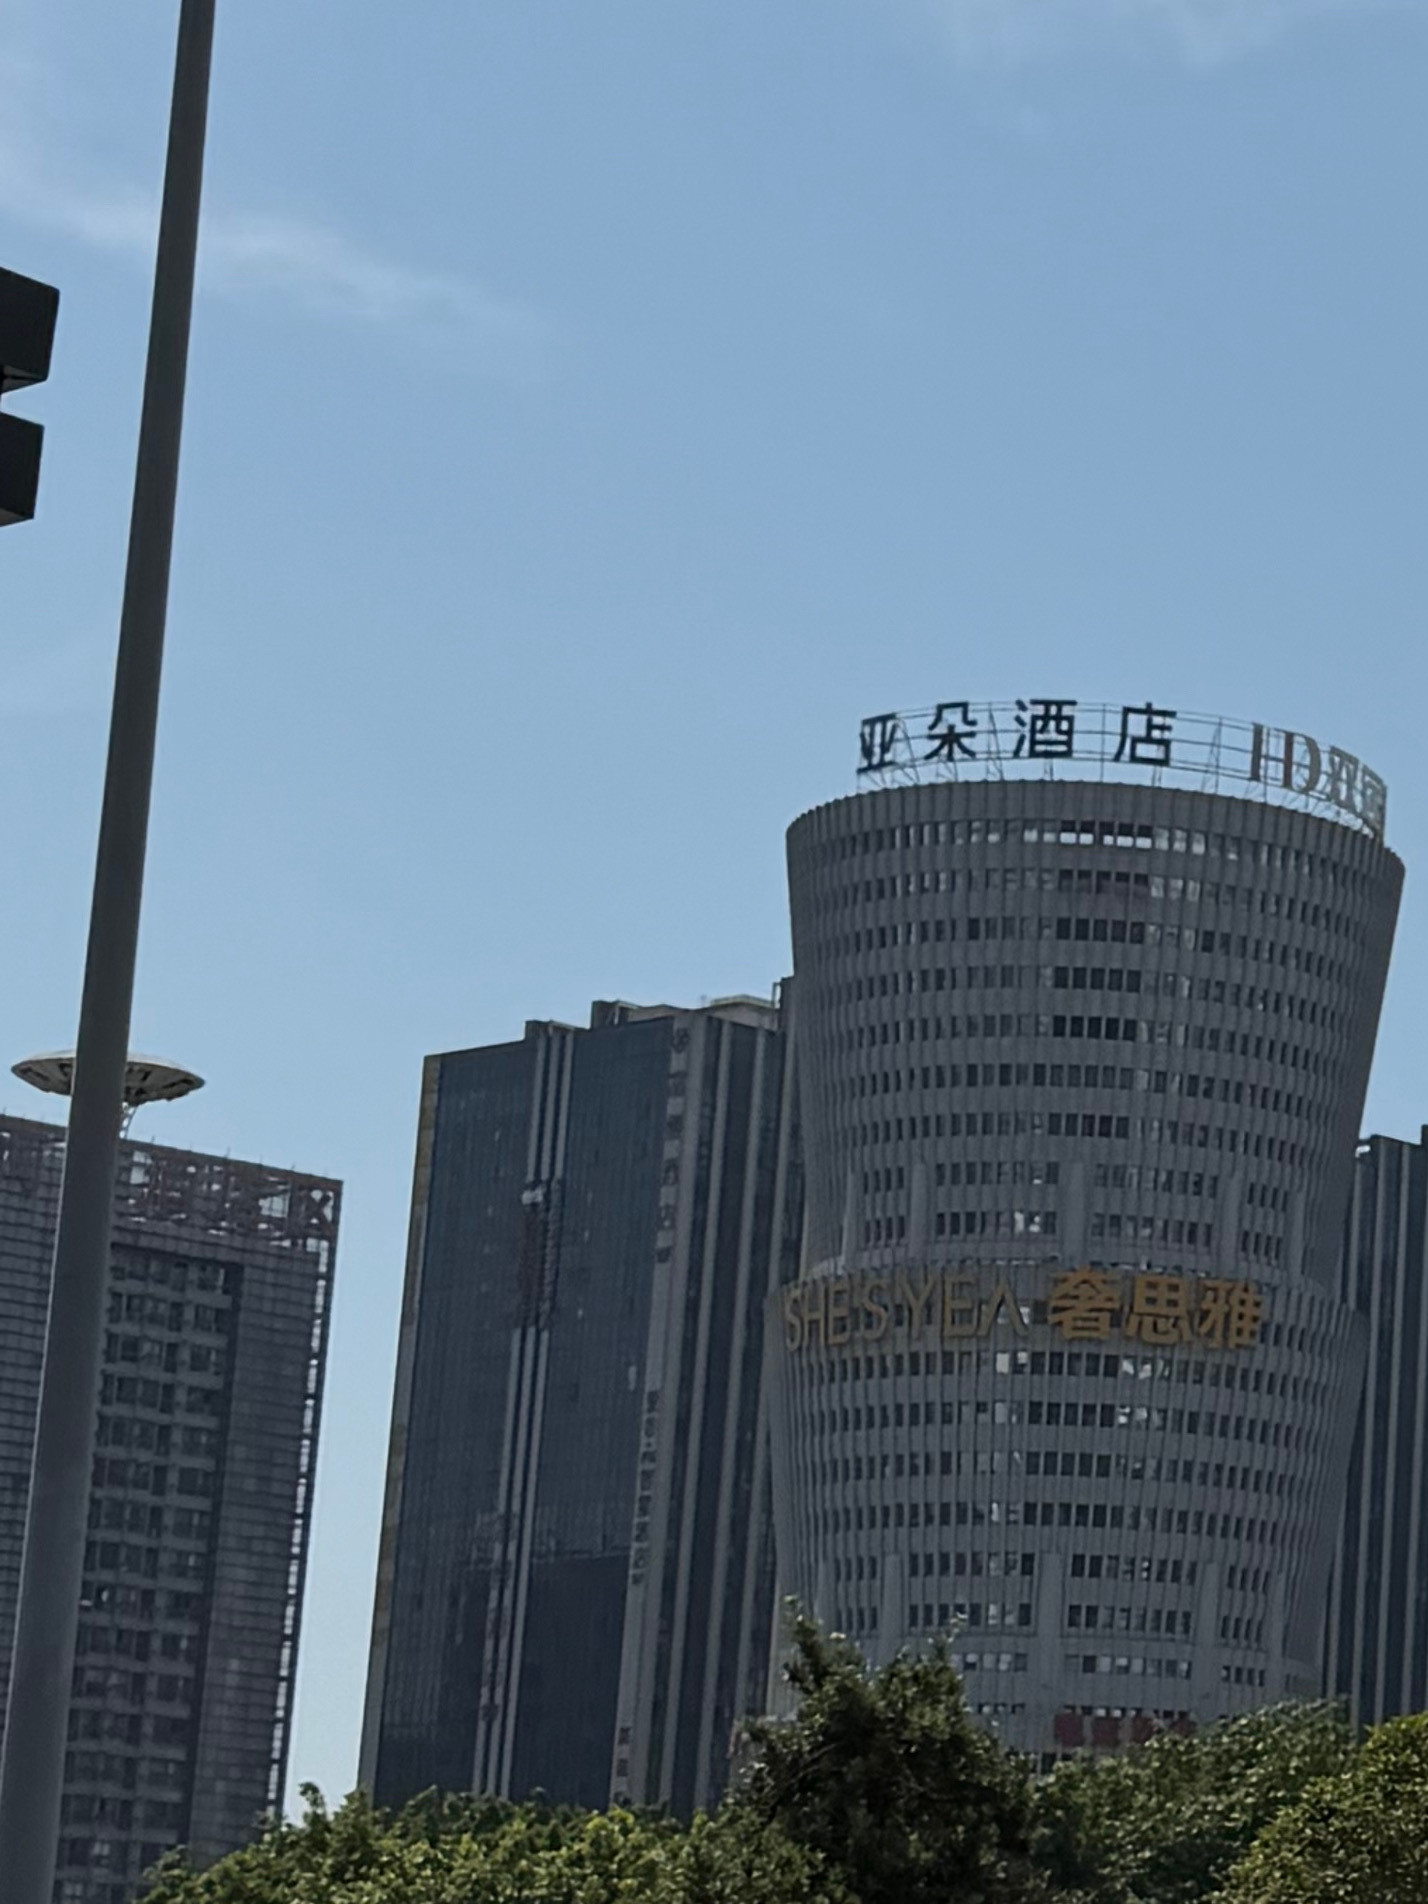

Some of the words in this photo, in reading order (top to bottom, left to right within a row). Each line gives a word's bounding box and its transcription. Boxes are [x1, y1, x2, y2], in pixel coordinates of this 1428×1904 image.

[856, 697, 1178, 774] 亚朵酒店
[1047, 1265, 1266, 1351] 奢思雅
